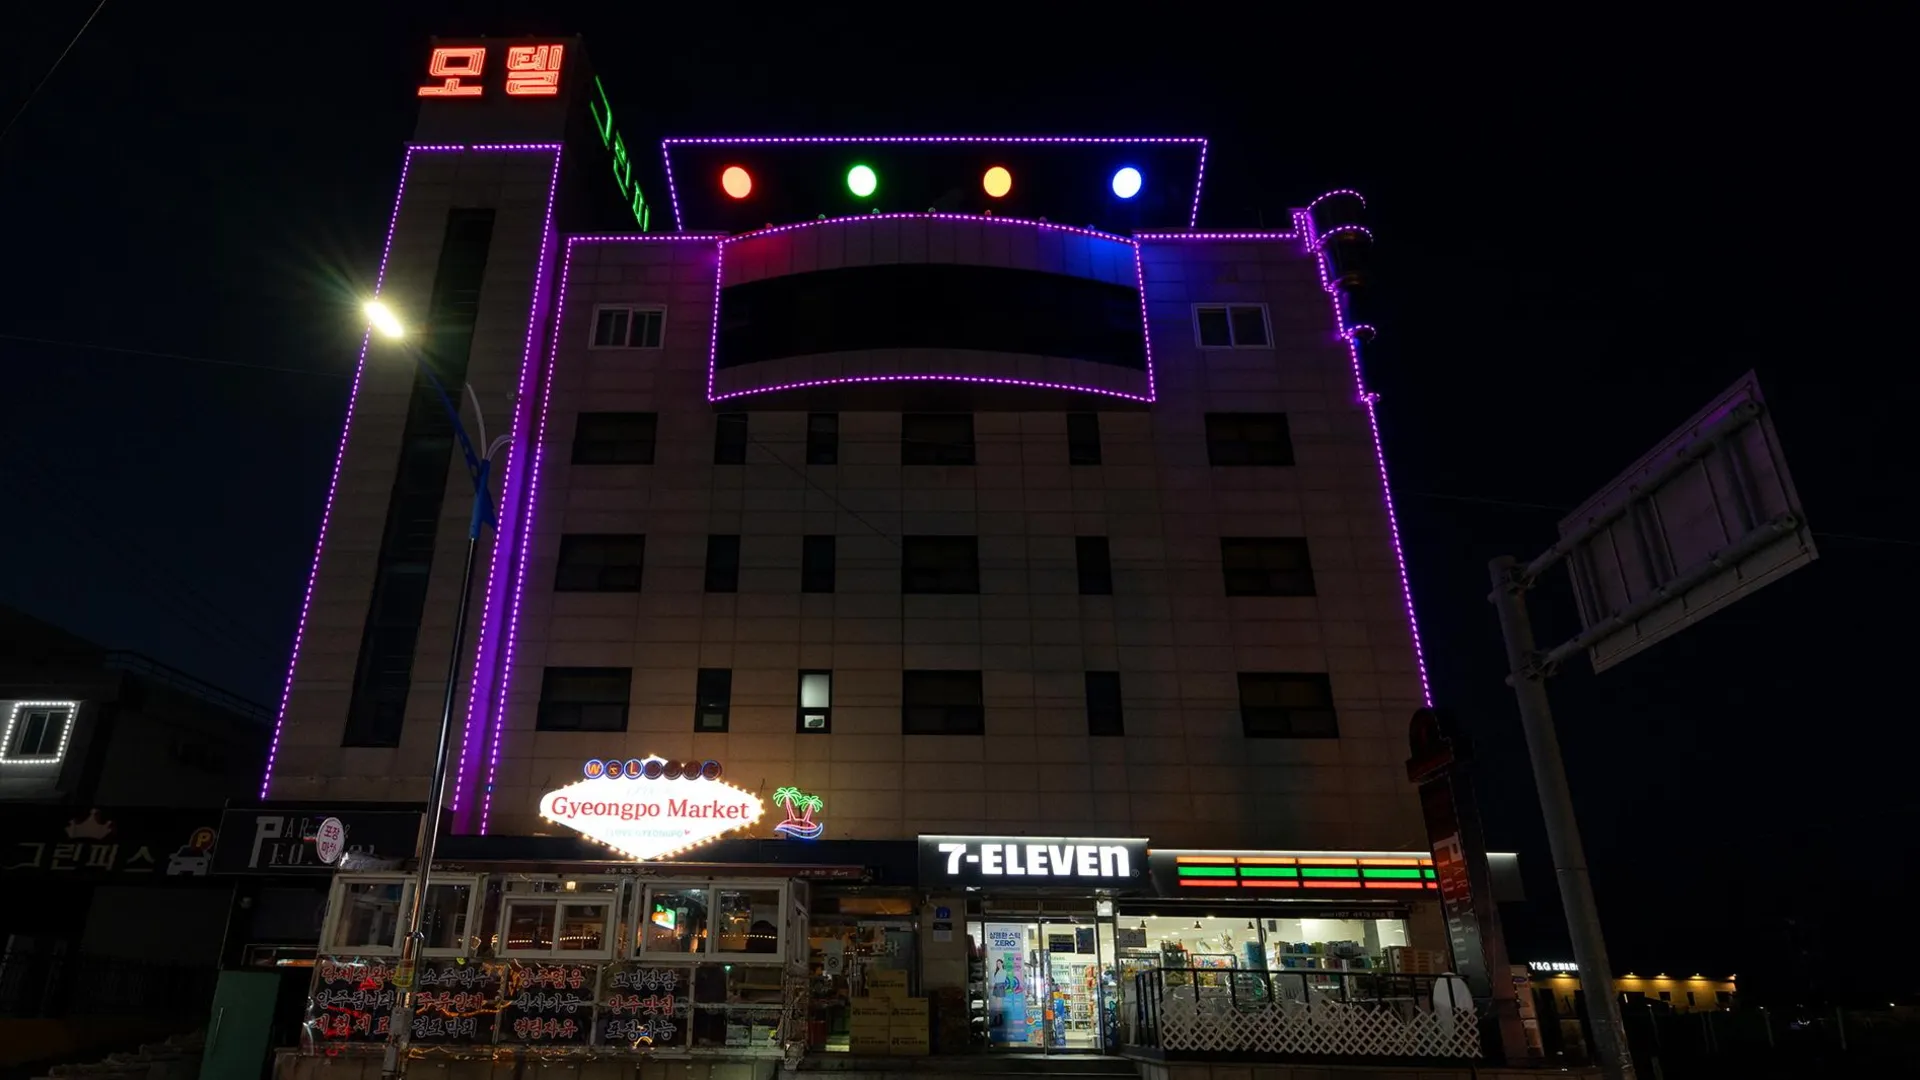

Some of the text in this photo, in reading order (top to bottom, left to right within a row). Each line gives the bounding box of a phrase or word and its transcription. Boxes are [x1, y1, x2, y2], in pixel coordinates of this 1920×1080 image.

[418, 46, 562, 96] 모텔
[552, 797, 750, 821] Gyeongpo Market
[324, 825, 340, 840] 포장
[1, 843, 156, 872] 그린피스
[1528, 962, 1552, 971] Y&G
[420, 967, 494, 989] 소주맥주
[611, 969, 679, 991] 고민상담
[515, 992, 582, 1013] 식사가능
[608, 994, 675, 1017] 안주맛집
[412, 1016, 478, 1039] 경포막회
[605, 1019, 677, 1041] 포장가능
